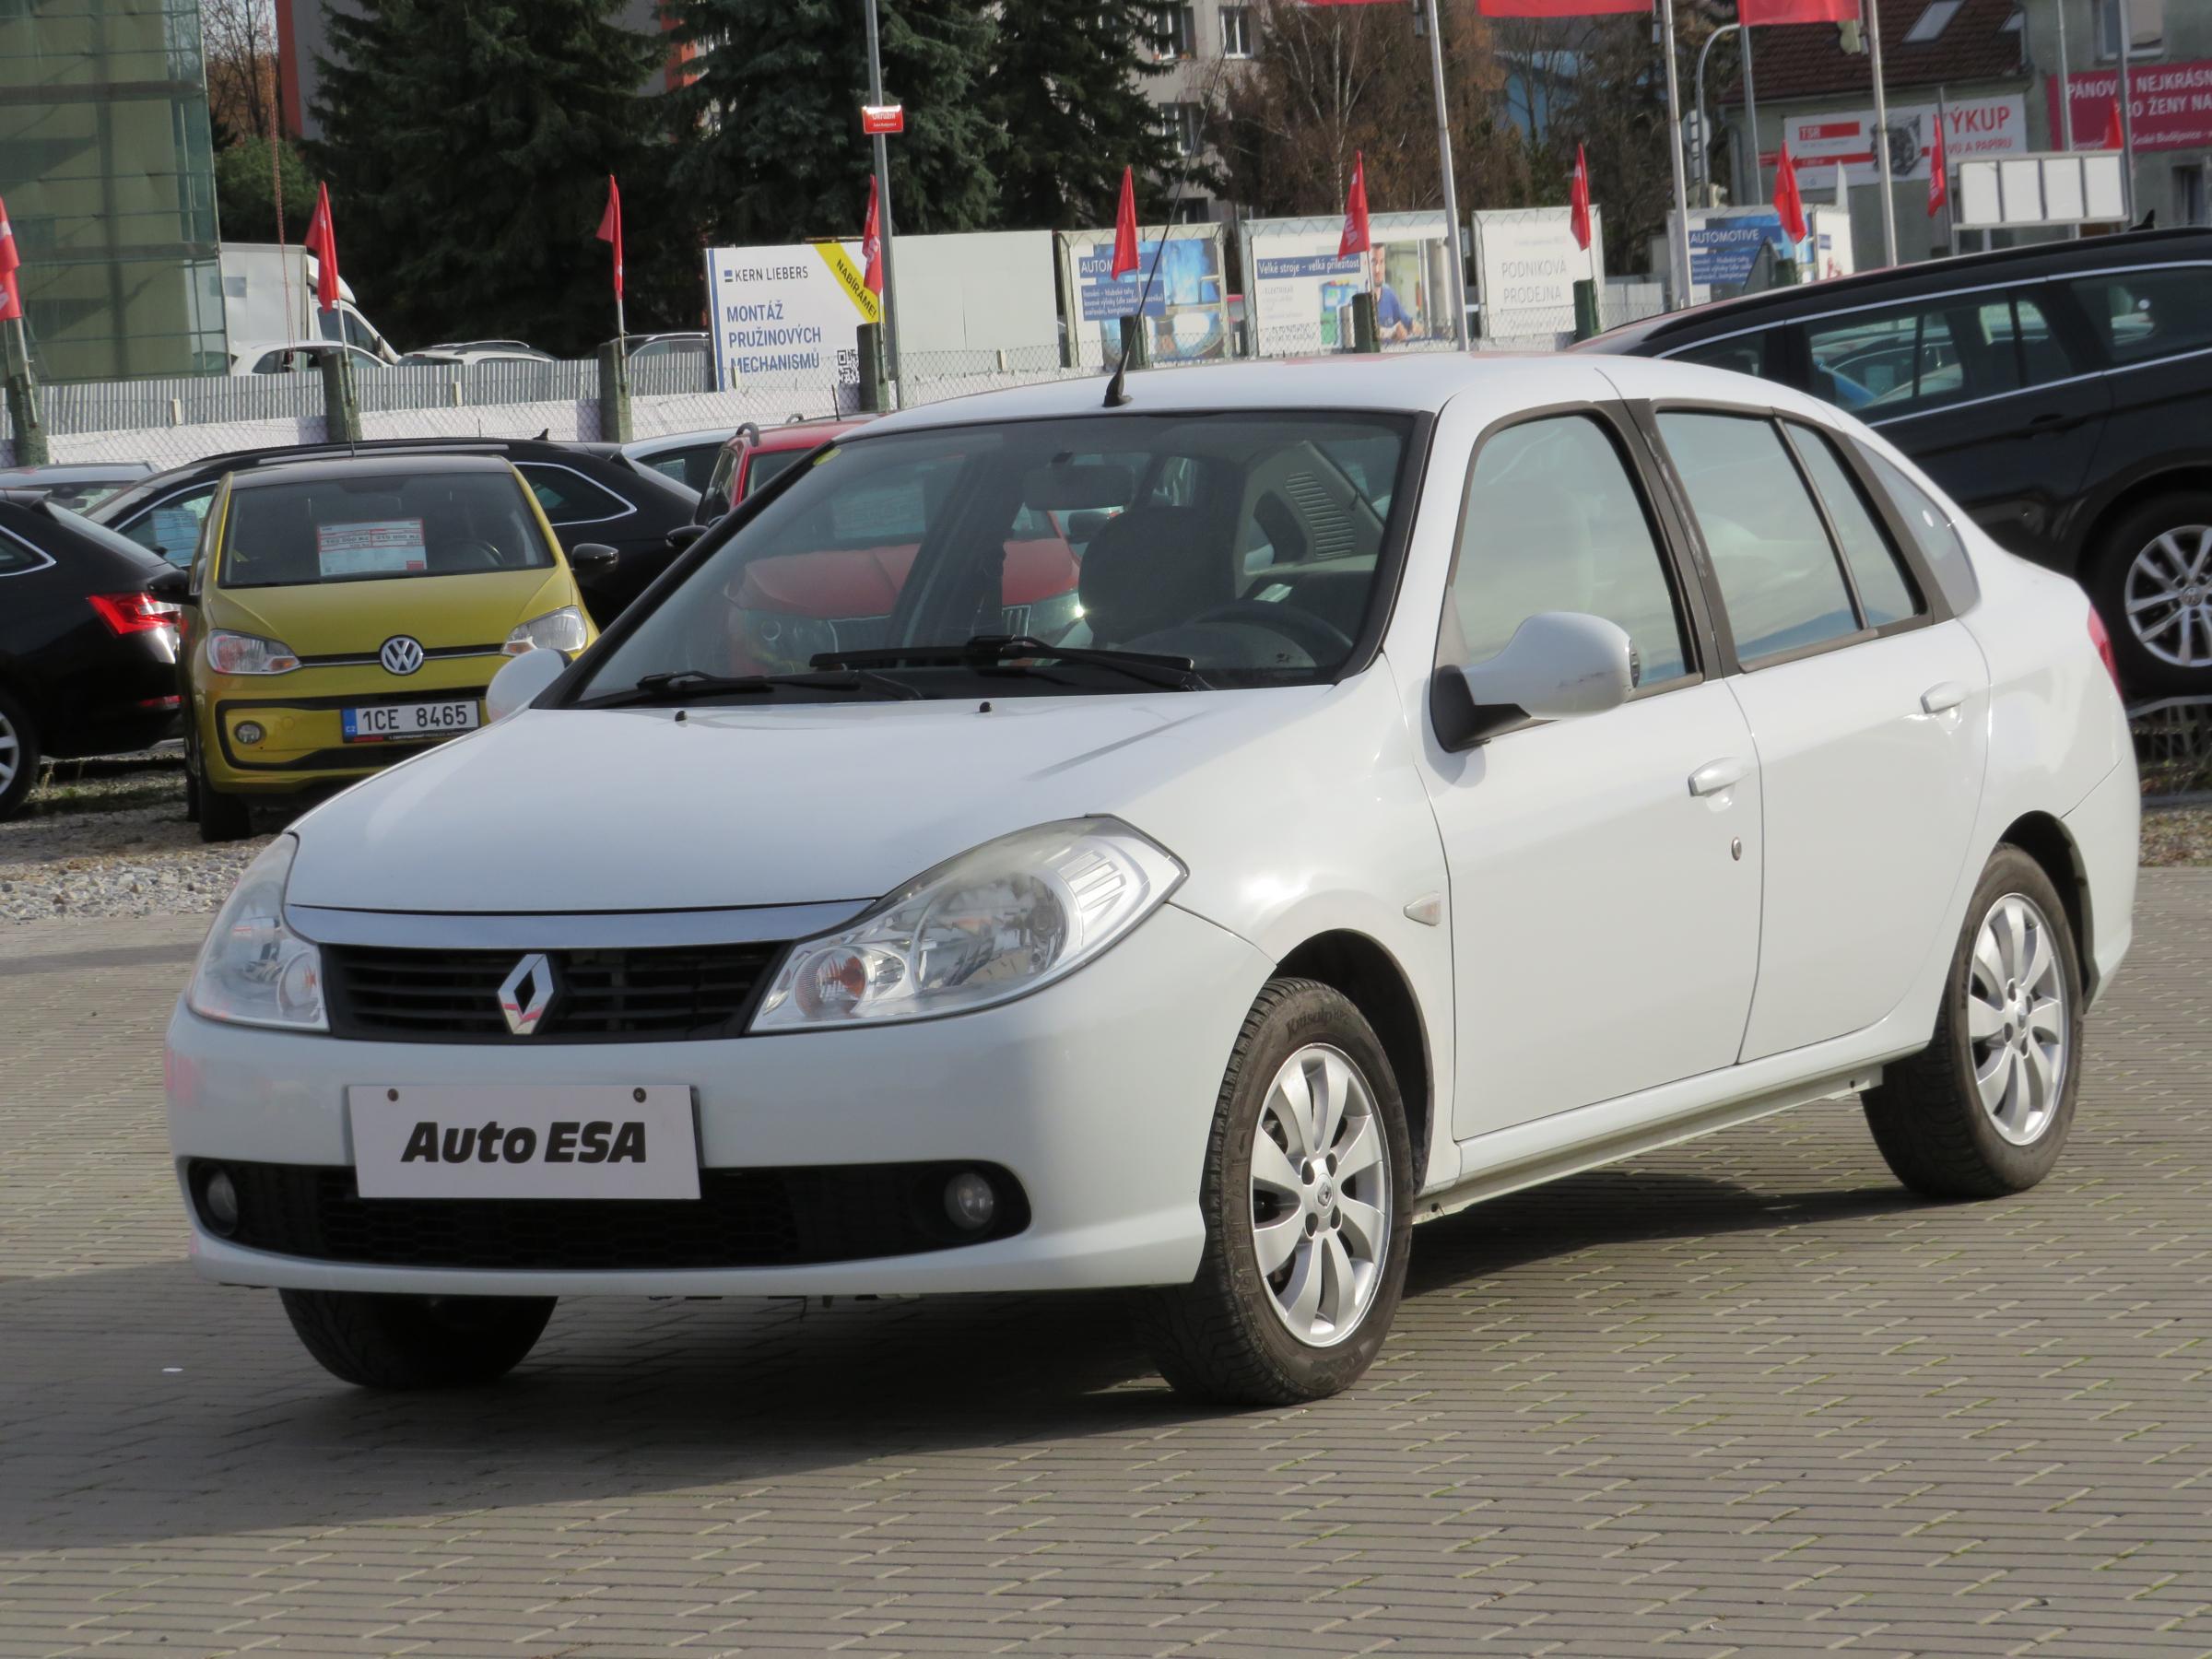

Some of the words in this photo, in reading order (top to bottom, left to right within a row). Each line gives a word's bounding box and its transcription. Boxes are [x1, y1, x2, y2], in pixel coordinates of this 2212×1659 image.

[2067, 78, 2131, 100] PÁNOV
[2147, 96, 2187, 116] ŽENY
[1690, 229, 1759, 243] AUTOMOTIVE
[735, 268, 764, 282] KERN
[766, 266, 808, 281] LIEBERS
[1258, 262, 1278, 275] Velké
[1279, 261, 1300, 276] stroje
[1309, 258, 1325, 271] velká
[1501, 255, 1567, 278] PODNIKOVÁ
[836, 258, 877, 319] NABÍRÁME!
[1503, 286, 1561, 303] PRODEJNA
[726, 300, 783, 322] MONTÁŽ
[729, 324, 821, 348] PRUŽINOVÝCH
[731, 347, 819, 374] MECHANISMŮ
[363, 709, 399, 731] 1CE
[416, 705, 467, 728] 8465
[400, 1121, 537, 1163] Auto
[544, 1121, 646, 1163] ESA
